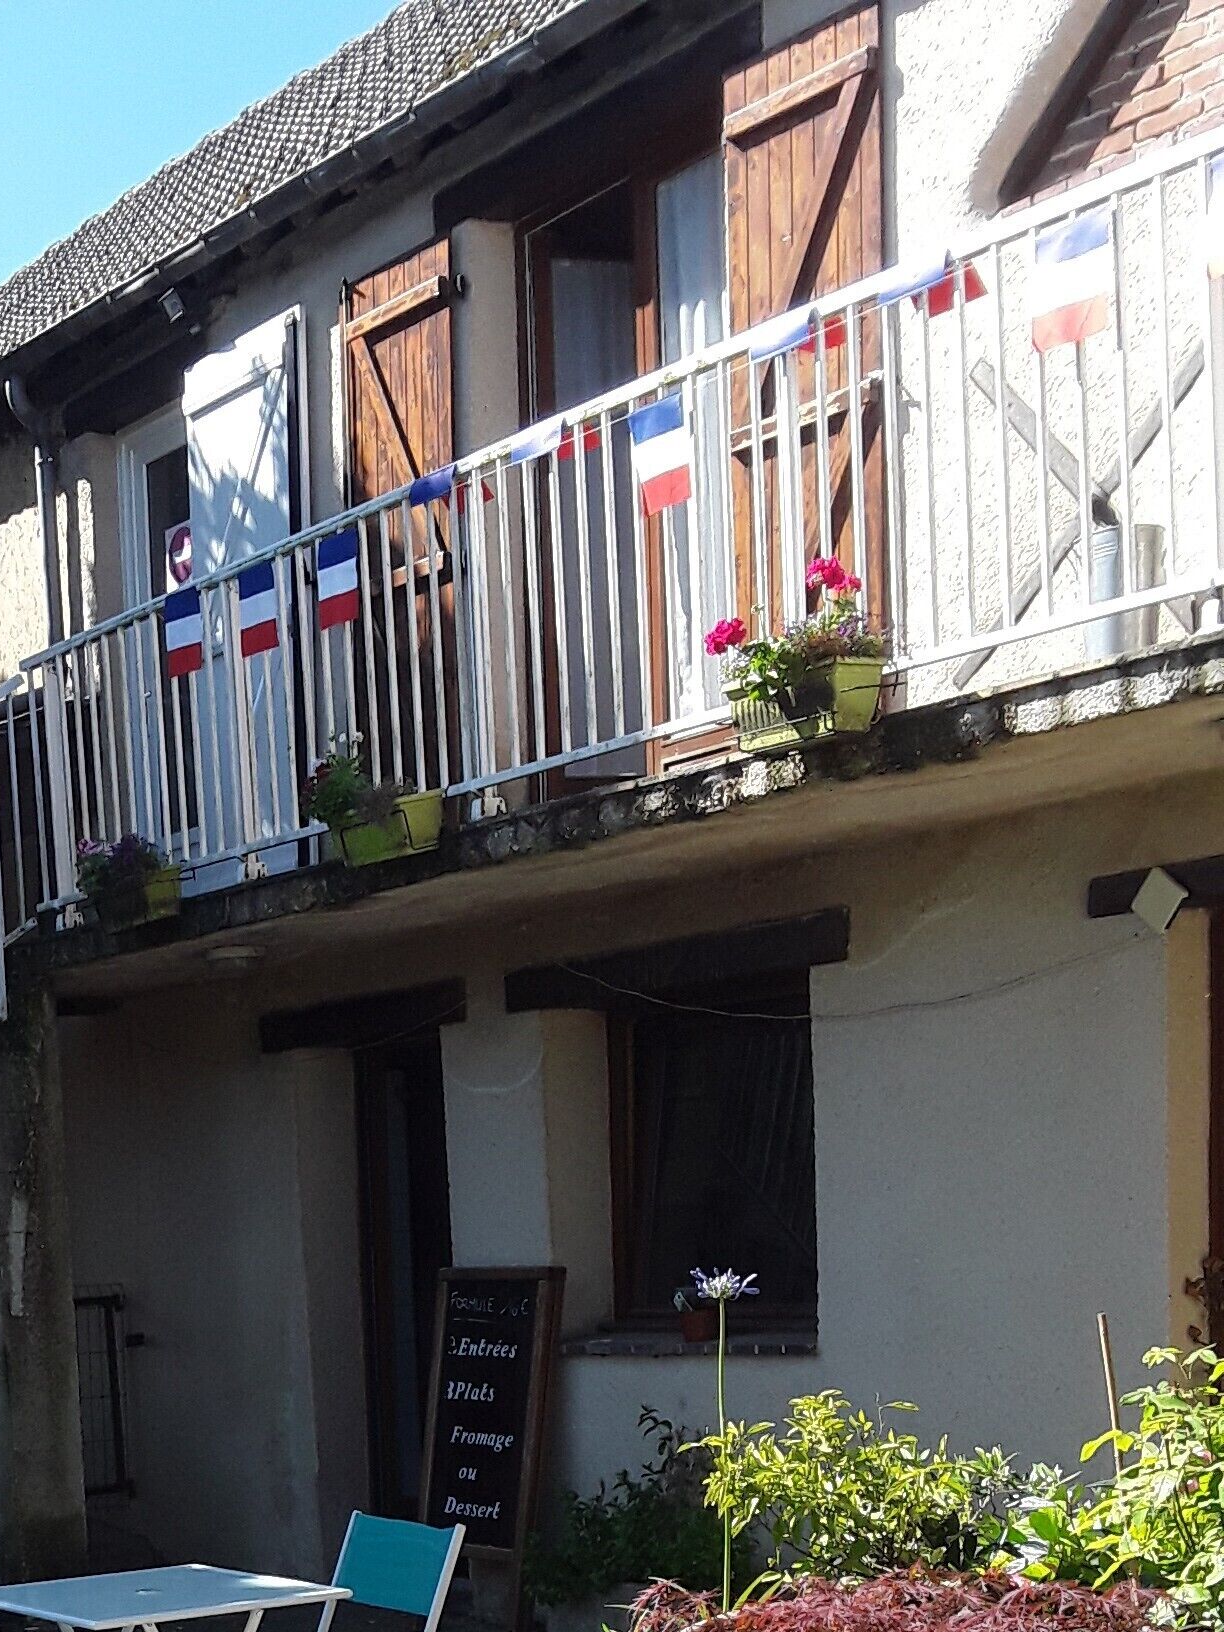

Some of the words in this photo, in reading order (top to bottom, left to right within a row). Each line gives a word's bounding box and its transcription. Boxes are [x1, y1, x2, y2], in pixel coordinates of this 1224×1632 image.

[450, 1426, 514, 1453] Fromage
[458, 1466, 478, 1481] ou
[444, 1496, 501, 1520] Dessert
